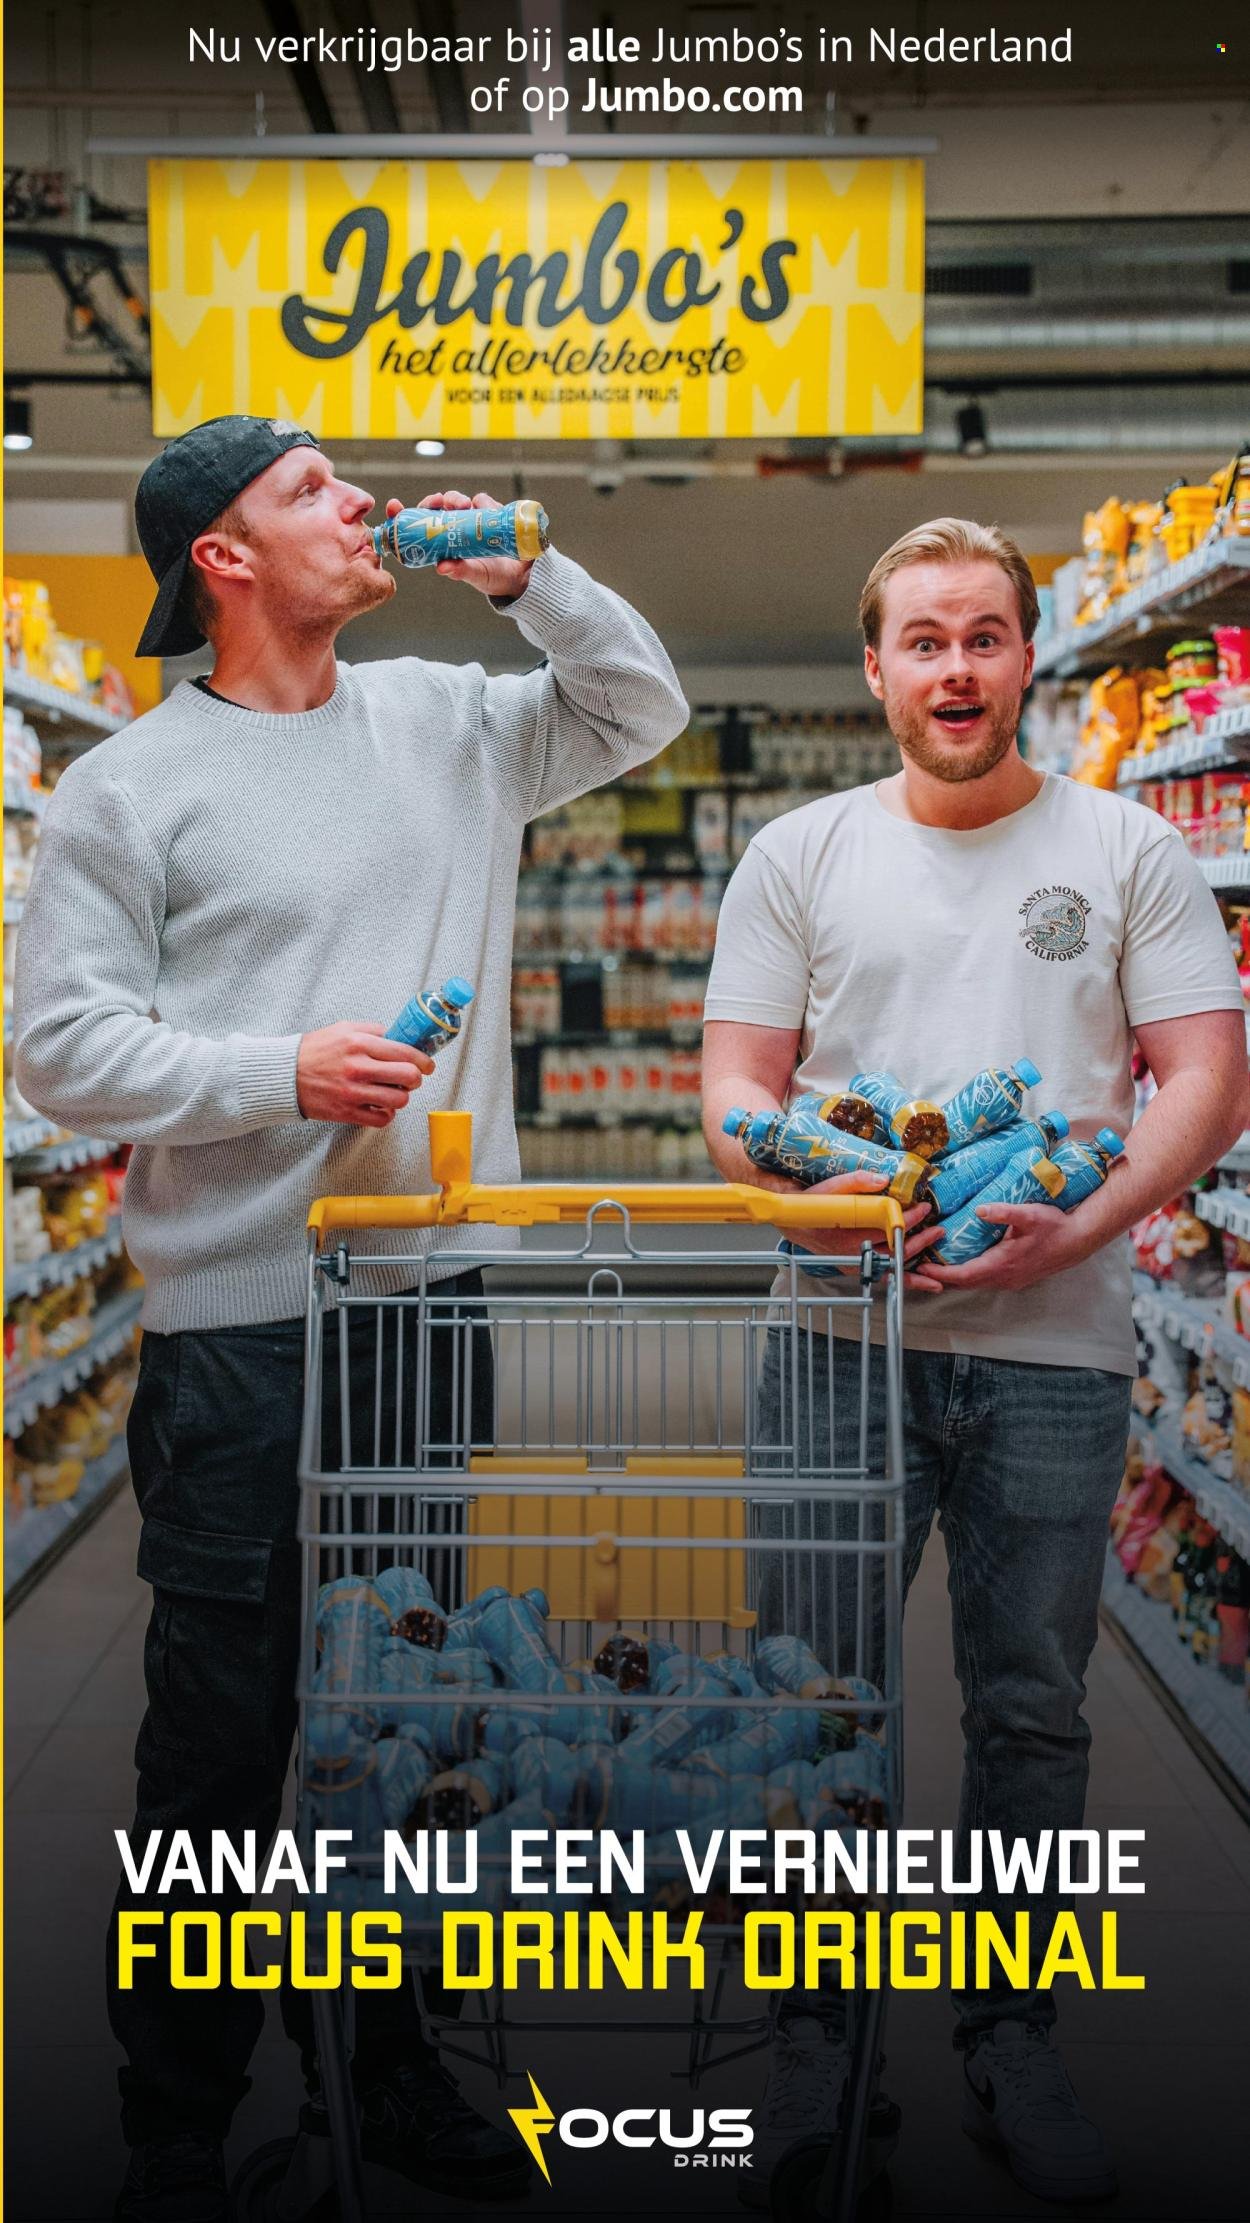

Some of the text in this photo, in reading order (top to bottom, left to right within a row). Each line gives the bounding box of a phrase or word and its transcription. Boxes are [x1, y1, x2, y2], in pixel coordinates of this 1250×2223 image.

[281, 201, 798, 360] Jumbo’s
[379, 337, 745, 379] het allerlekkerste
[447, 388, 491, 402] VOOR
[1018, 885, 1092, 916] SANTA MONICA
[1024, 939, 1090, 962] CALIFORNIA
